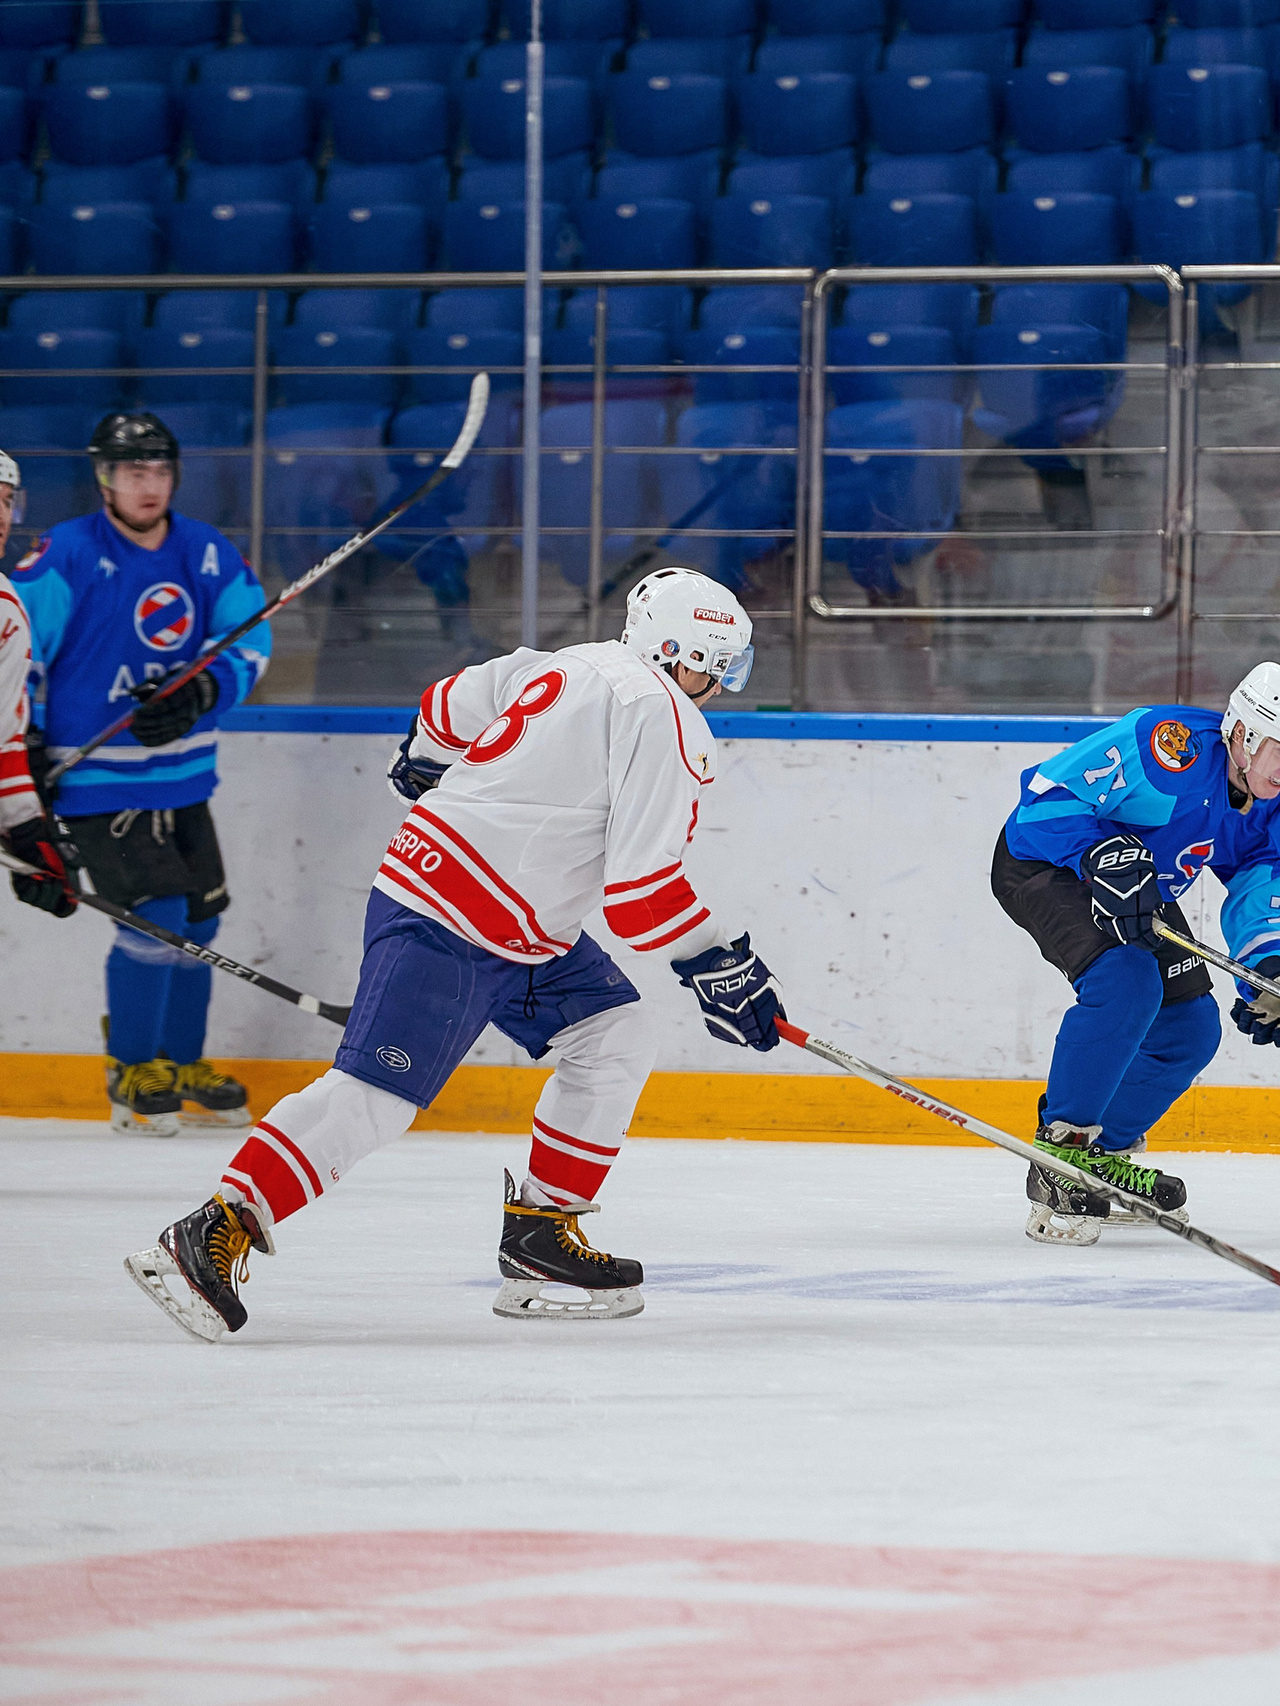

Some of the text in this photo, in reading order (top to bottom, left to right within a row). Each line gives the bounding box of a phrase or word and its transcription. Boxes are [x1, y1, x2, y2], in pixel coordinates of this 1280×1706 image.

[696, 609, 733, 624] FONBET
[708, 632, 727, 641] CCM
[459, 667, 568, 767] 8
[388, 827, 443, 873] НЕРГО
[884, 1083, 968, 1128] BAUER
